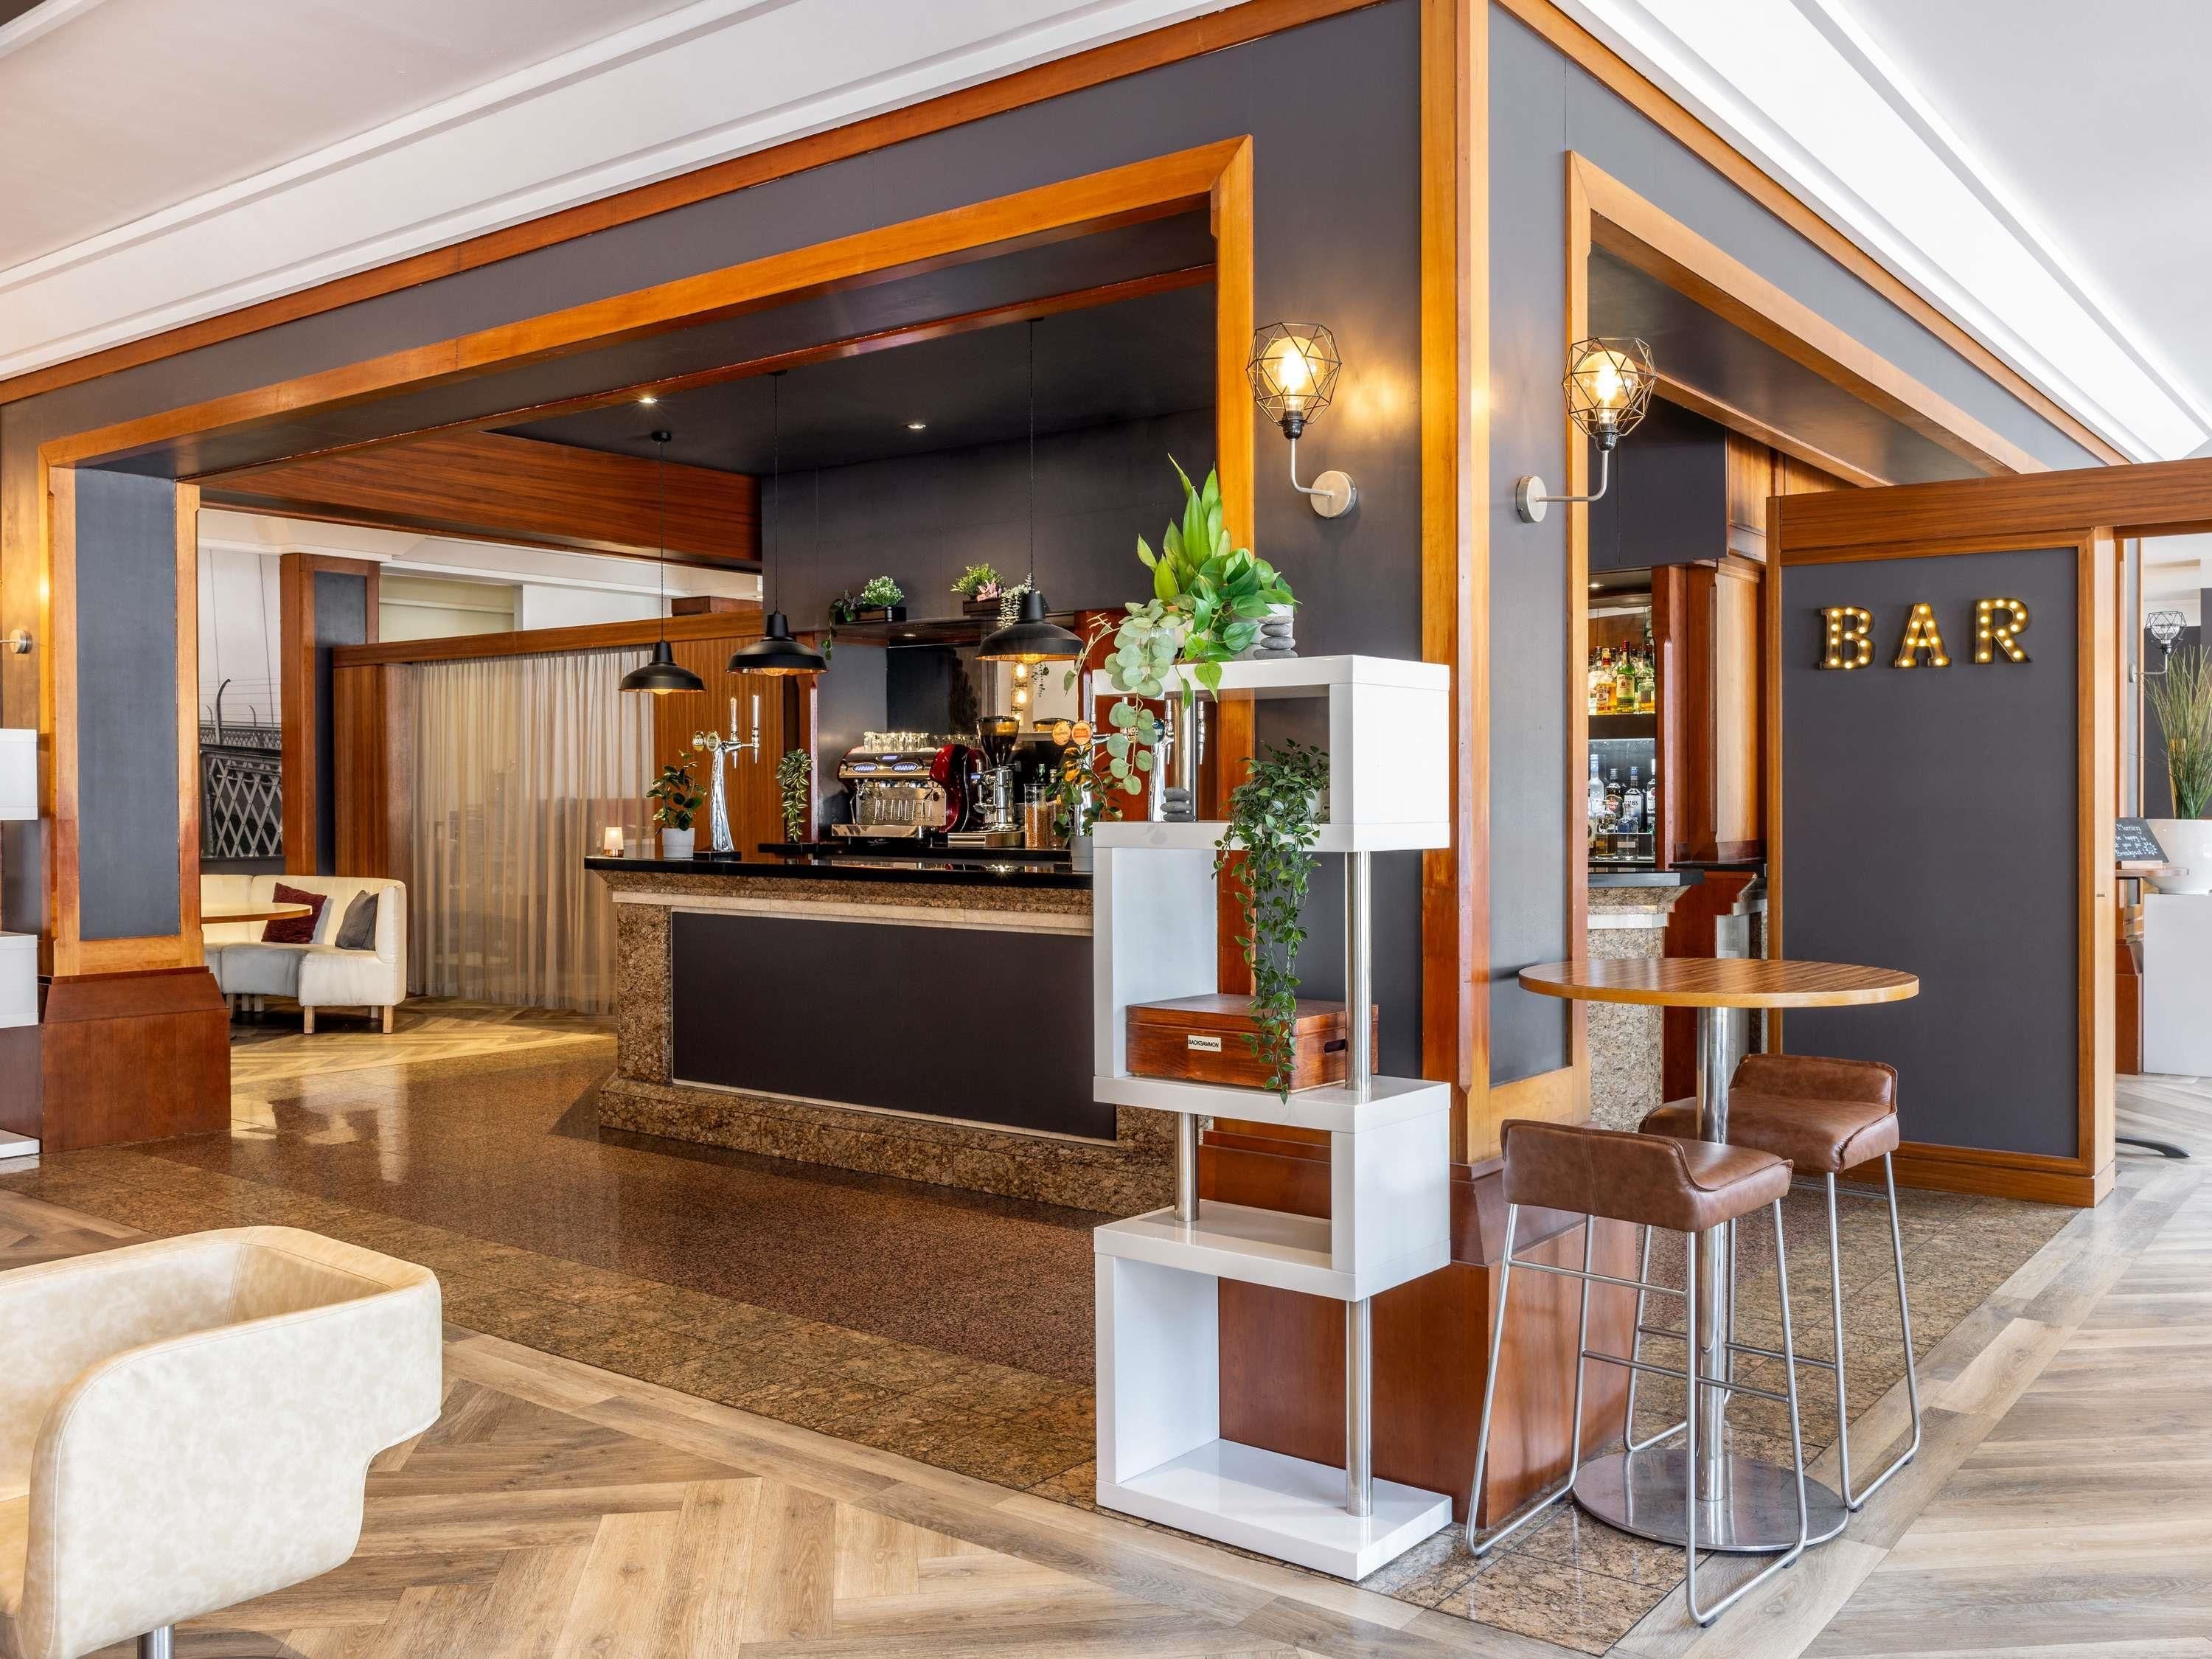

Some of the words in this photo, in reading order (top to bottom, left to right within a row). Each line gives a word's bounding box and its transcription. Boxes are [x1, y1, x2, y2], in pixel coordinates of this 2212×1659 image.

[1819, 598, 2031, 669] BAR
[2116, 823, 2142, 834] Morning
[2122, 834, 2140, 843] happy
[1189, 1039, 1220, 1048] BACKGAMMON
